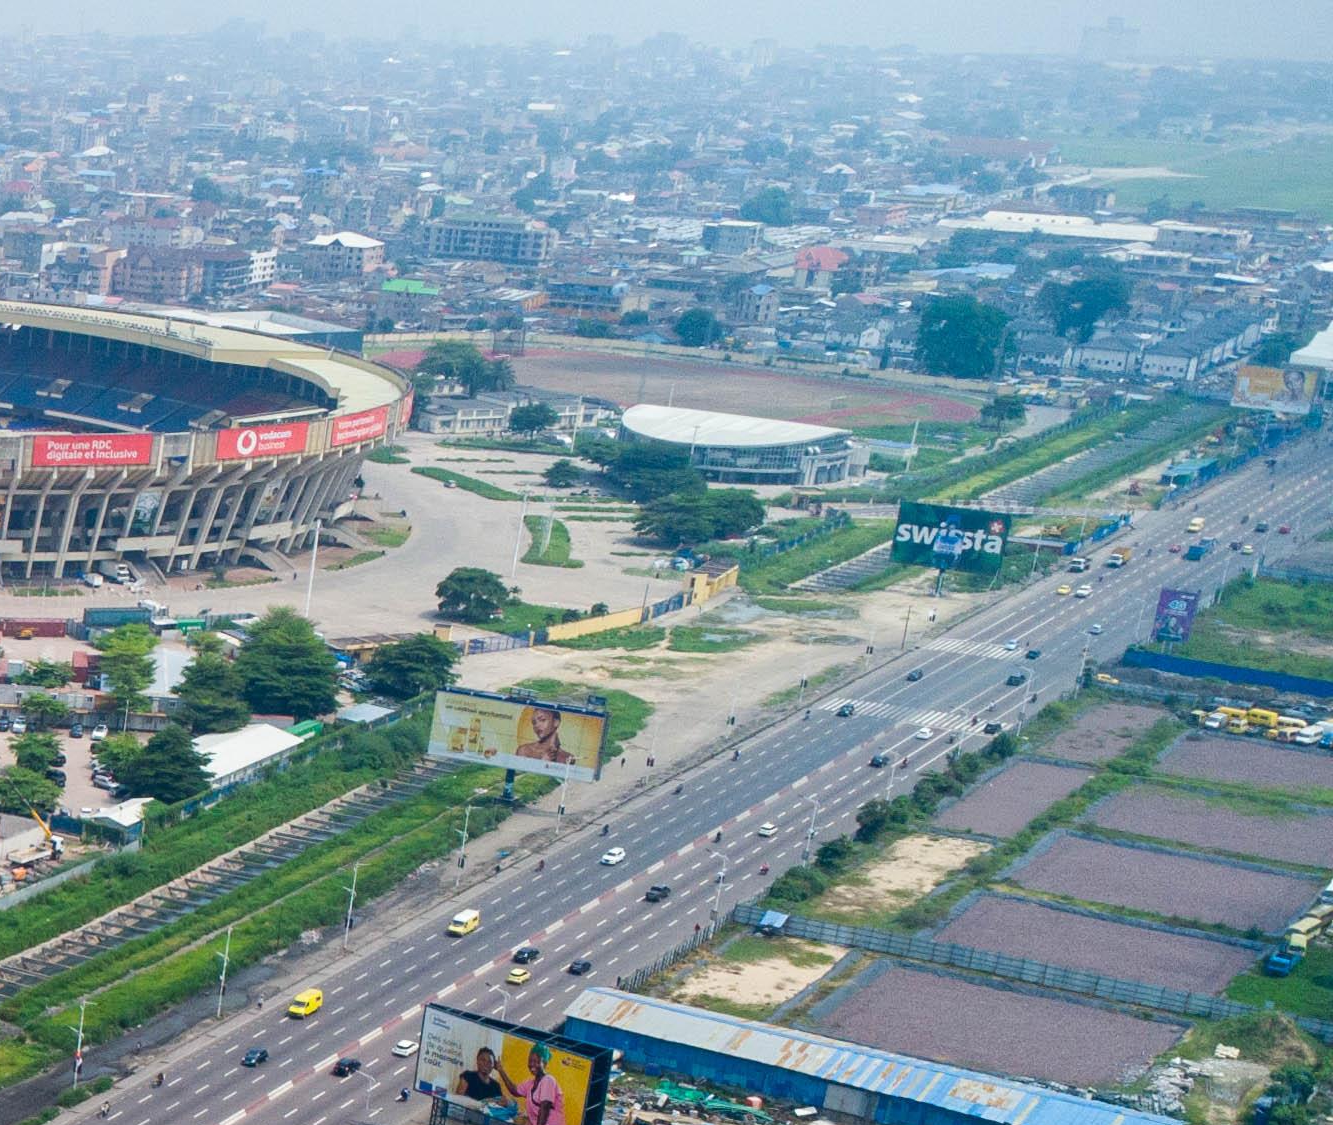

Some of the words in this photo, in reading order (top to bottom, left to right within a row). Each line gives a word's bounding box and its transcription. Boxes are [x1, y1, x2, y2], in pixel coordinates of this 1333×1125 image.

[47, 440, 70, 450] Pour
[72, 442, 90, 450] une
[92, 440, 112, 449] RDC
[46, 450, 83, 461] digitale
[84, 450, 93, 459] et
